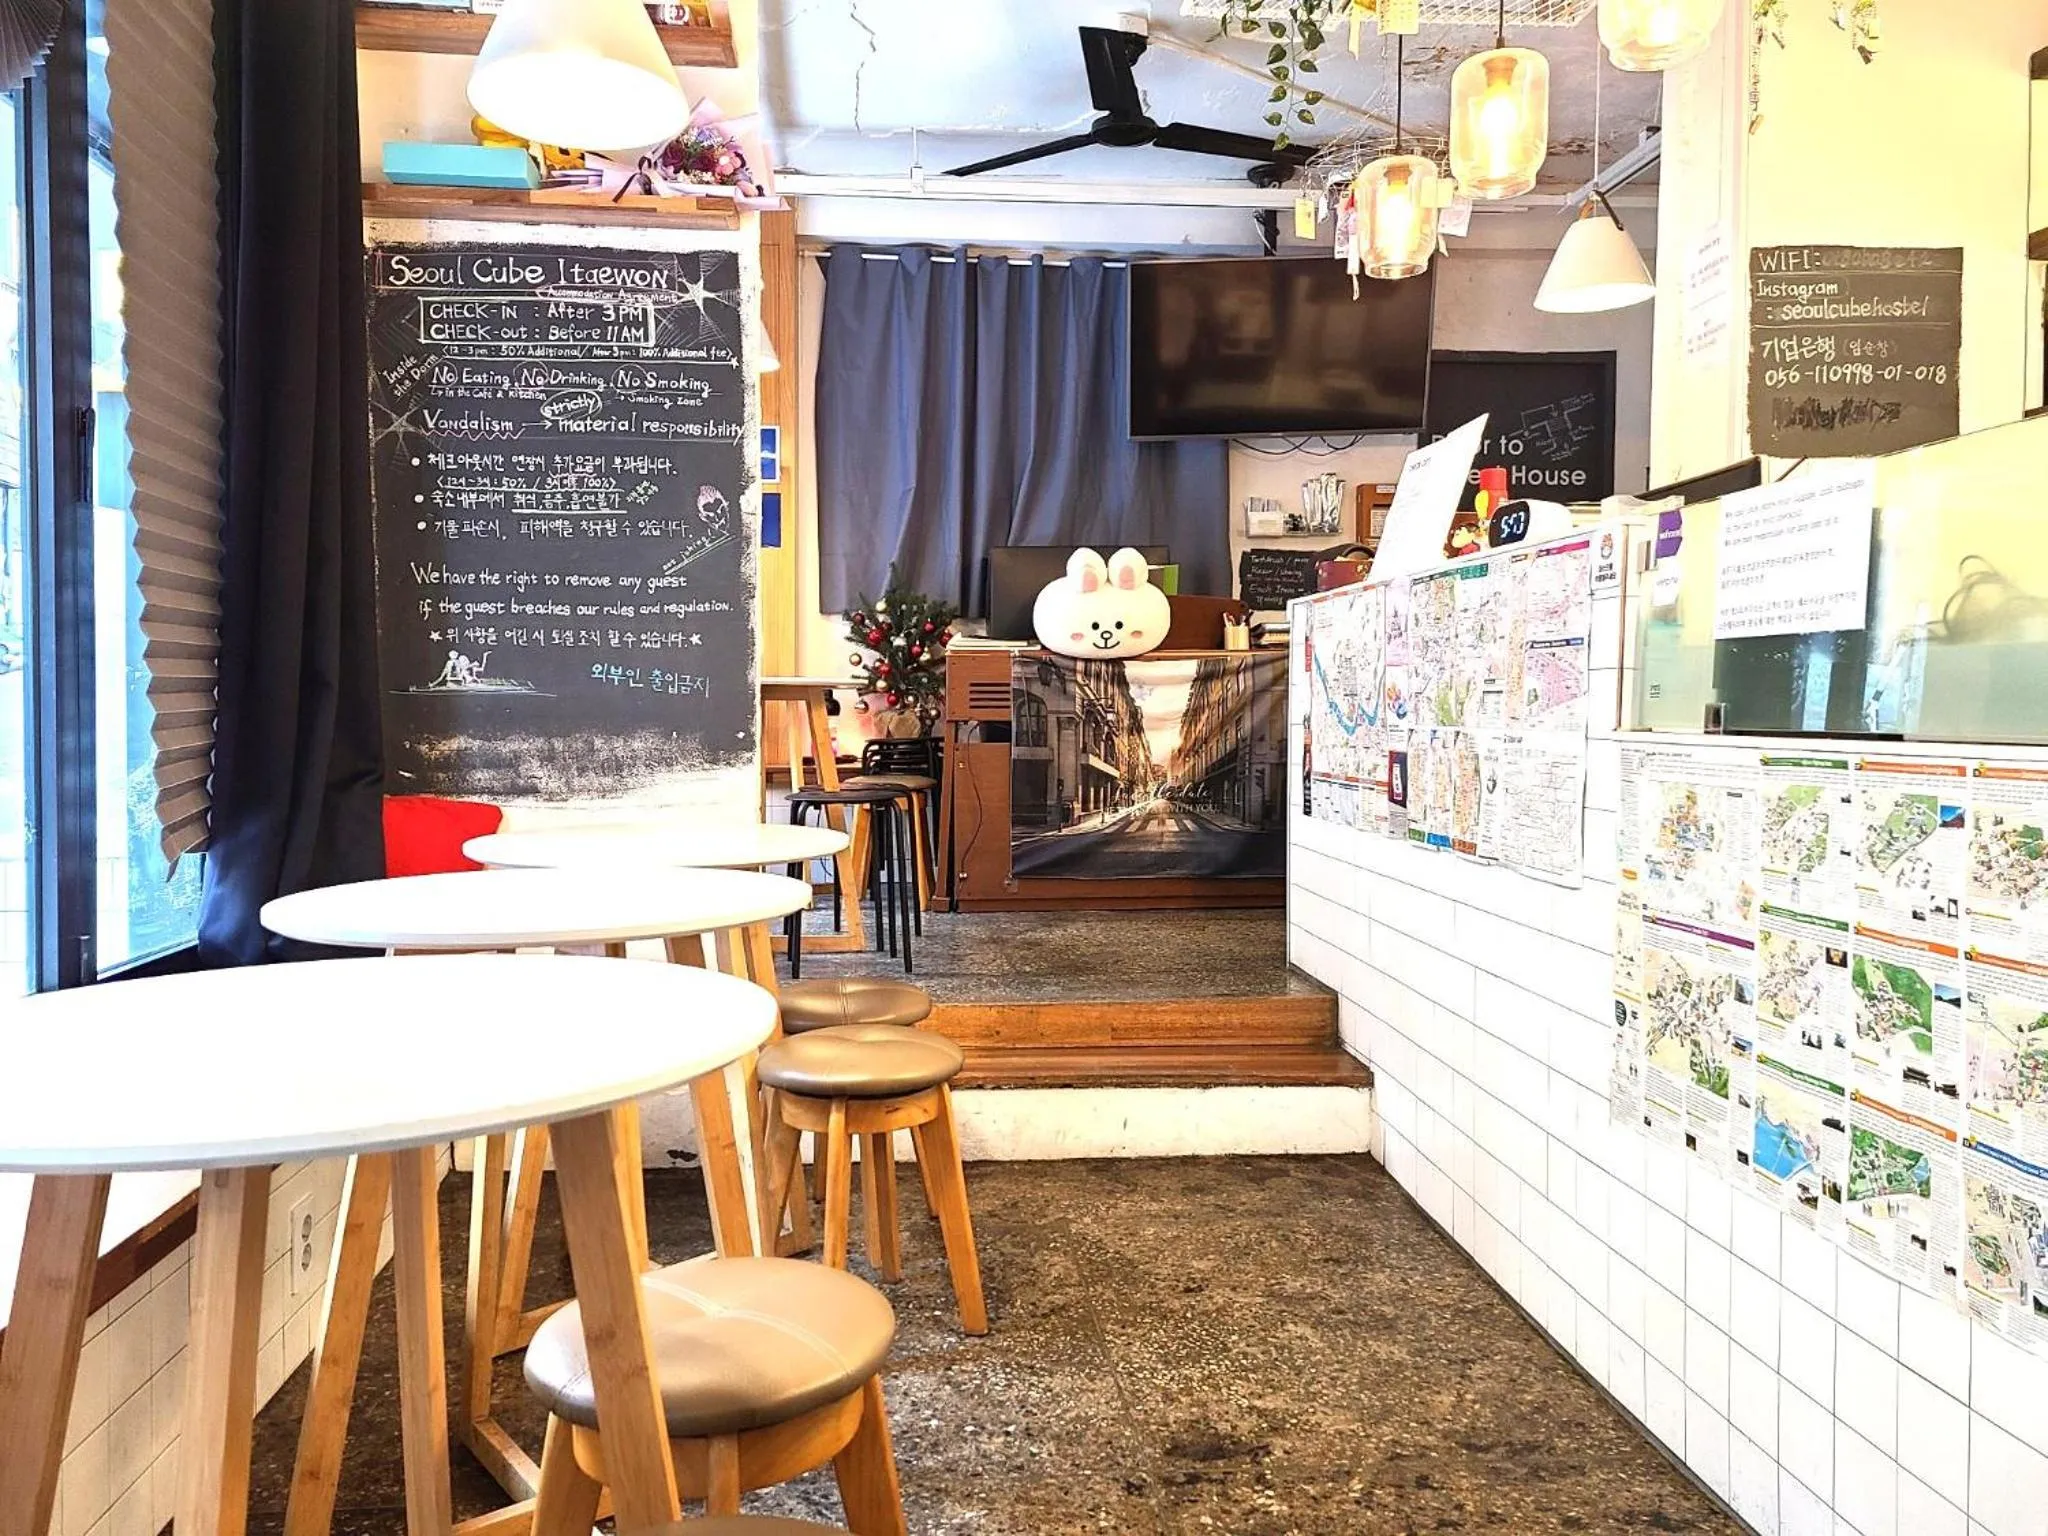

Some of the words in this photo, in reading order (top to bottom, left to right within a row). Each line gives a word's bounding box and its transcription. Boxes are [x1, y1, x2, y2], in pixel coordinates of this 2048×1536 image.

[389, 255, 464, 285] Seoul
[472, 256, 545, 285] Cube
[1757, 279, 1839, 303] Instagram
[429, 302, 518, 320] CHECK-IN
[547, 303, 595, 320] After
[548, 324, 601, 343] Before
[499, 345, 525, 356] 50%
[1761, 335, 1836, 363] 기업은행
[382, 353, 418, 385] Inside
[1764, 362, 1947, 389] 056-110998-01-018
[393, 378, 413, 397] the
[432, 365, 456, 384] No
[521, 368, 546, 387] No
[617, 371, 641, 389] No
[645, 371, 711, 397] Smoking
[445, 388, 454, 397] in
[457, 388, 470, 397] the
[544, 393, 597, 418] strictly
[558, 411, 637, 433] material
[642, 419, 746, 447] responsibility
[1500, 434, 1524, 455] to
[427, 452, 505, 471] 체크아웃시간
[511, 454, 546, 472] 연장시
[554, 454, 606, 474] 추가요금이
[611, 455, 678, 475] 부과됩니다.
[1511, 464, 1587, 486] House
[501, 475, 527, 489] 50%
[430, 489, 506, 510] 숙소내부에서
[519, 518, 574, 540] 피해액을
[579, 518, 618, 538] 청구할
[621, 520, 634, 536] 수
[637, 519, 694, 539] 있습니다.
[410, 561, 439, 584] We
[442, 564, 476, 584] have
[479, 568, 501, 585] the
[505, 570, 538, 592] right
[544, 573, 560, 585] to
[564, 574, 612, 587] remove
[618, 576, 642, 594] any
[647, 575, 688, 594] guest
[418, 599, 433, 621] if
[438, 596, 462, 614] the
[464, 600, 505, 621] guest
[510, 597, 571, 616] breaches
[576, 604, 600, 616] our
[603, 600, 635, 617] rules
[639, 601, 660, 614] and
[445, 627, 460, 644] 위
[463, 626, 499, 646] 사항을
[551, 628, 575, 647] 퇴실
[577, 630, 601, 647] 조치
[640, 631, 688, 648] 있습니다.
[590, 663, 645, 688] 외부인
[648, 668, 710, 699] 출입금지
